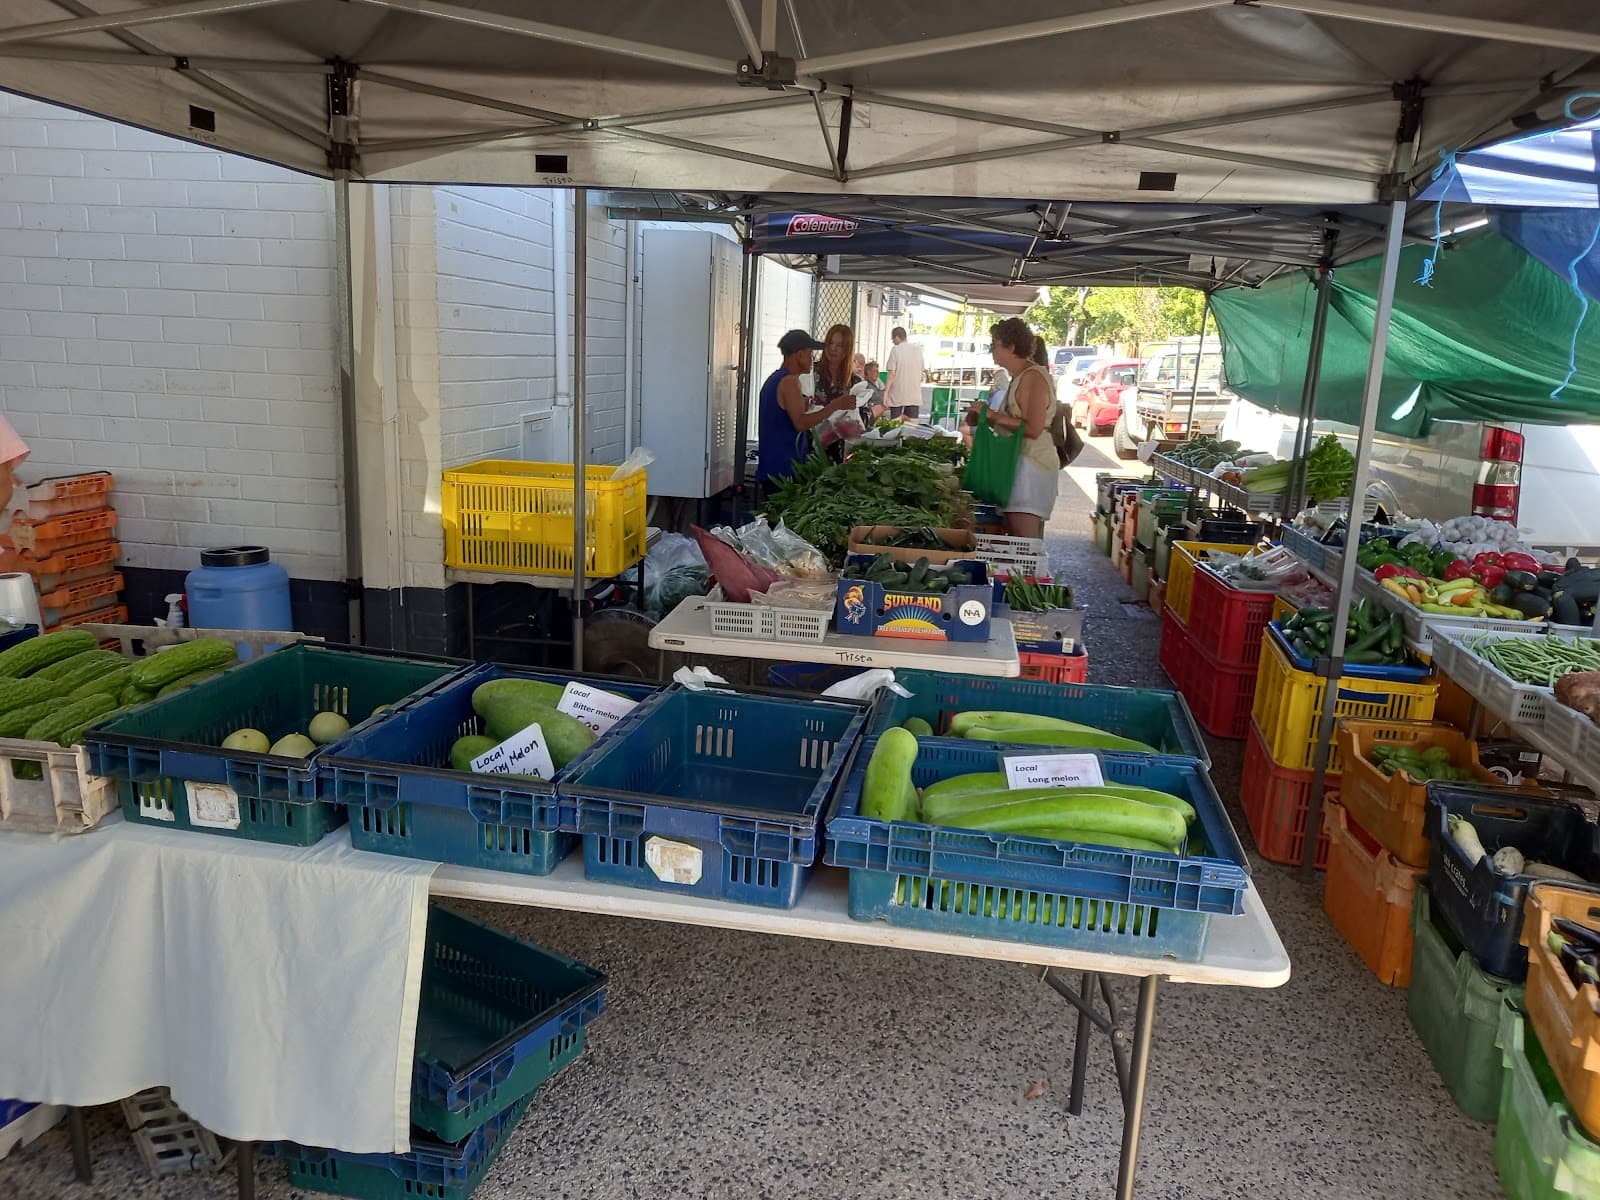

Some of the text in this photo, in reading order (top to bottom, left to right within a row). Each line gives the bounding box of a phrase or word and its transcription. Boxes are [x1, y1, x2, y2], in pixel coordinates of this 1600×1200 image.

[794, 217, 843, 232] Coleman
[883, 593, 942, 613] SUNLAND
[835, 651, 873, 663] Trista
[568, 687, 591, 699] Local
[573, 701, 620, 721] Bitter melon
[476, 746, 505, 769] Local
[508, 739, 539, 766] Melon
[1015, 764, 1038, 772] Local
[1027, 774, 1080, 784] Long melon
